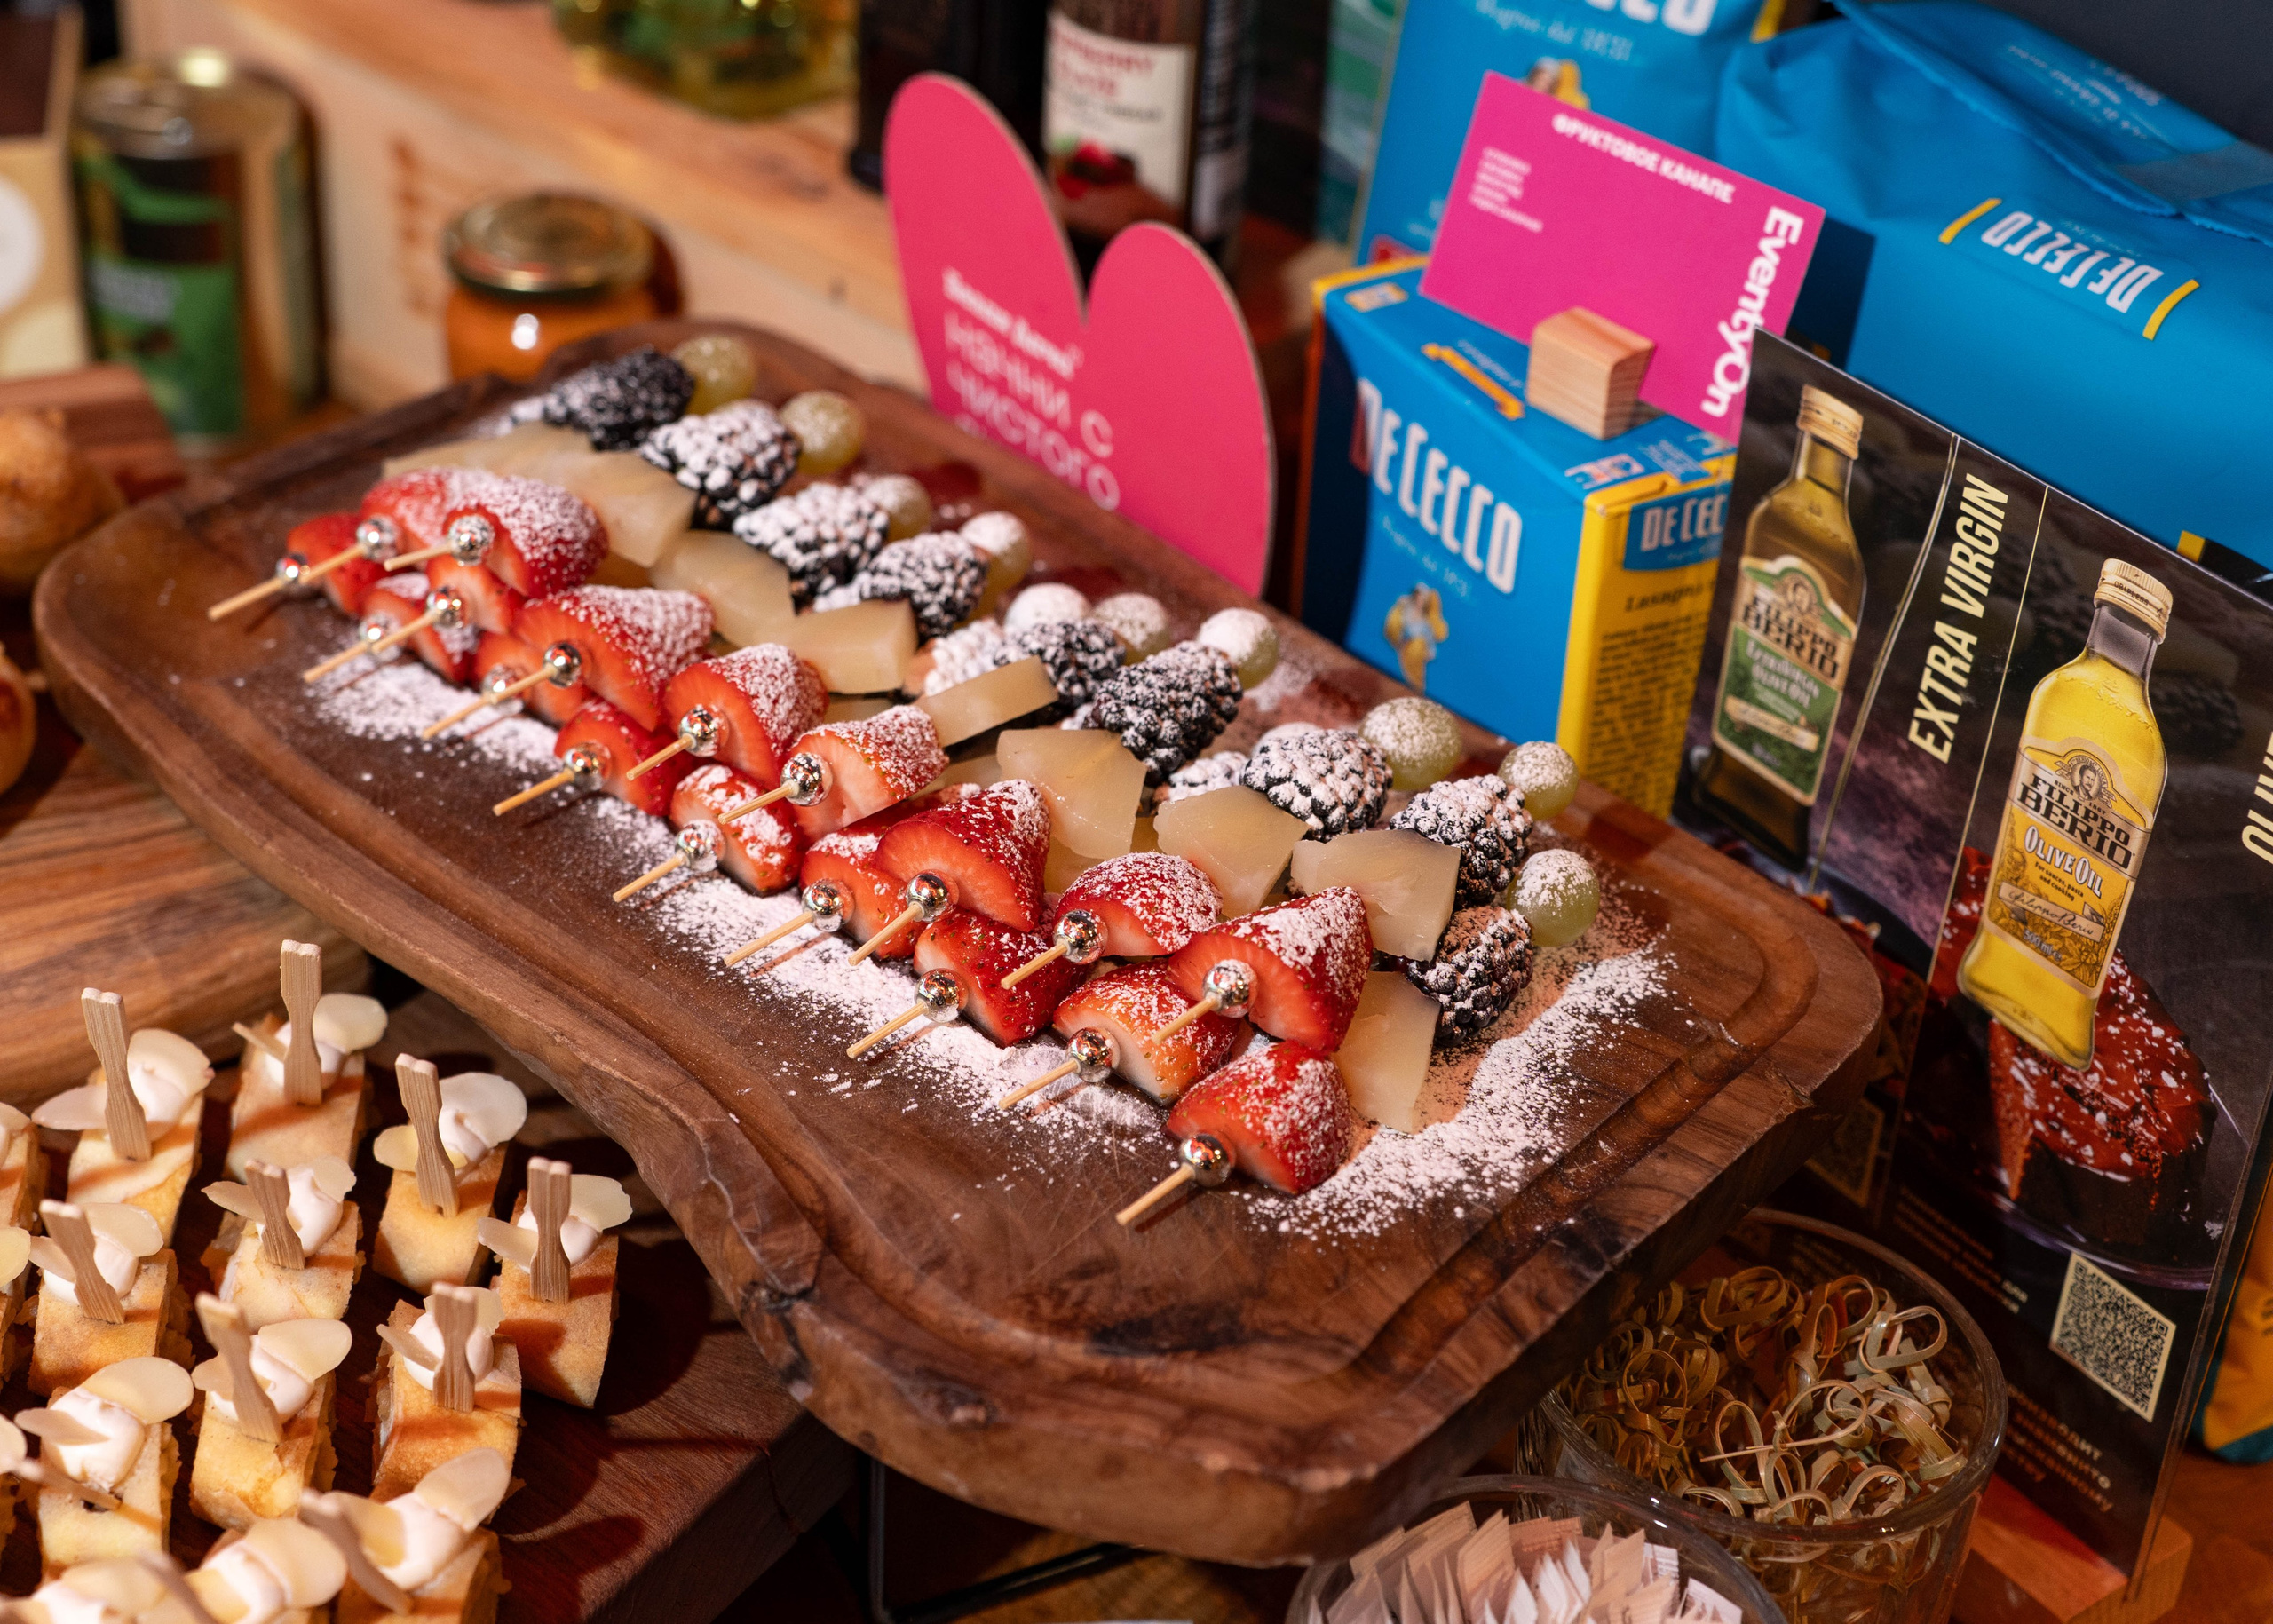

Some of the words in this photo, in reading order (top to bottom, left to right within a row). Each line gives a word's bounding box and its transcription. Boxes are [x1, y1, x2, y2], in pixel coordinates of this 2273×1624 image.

[1550, 112, 1661, 173] ФРУКТОВОЕ
[1659, 156, 1736, 204] КАНАПЕ
[1699, 205, 1804, 418] EventyOn
[1679, 494, 1728, 543] CEC
[1940, 473, 2009, 617] VIRGIN
[1907, 622, 1979, 764] EXTRA
[2016, 781, 2133, 870] BERIO
[2030, 772, 2131, 846] FILIPPO
[2024, 825, 2077, 875] OLIVE
[2073, 856, 2103, 899] OIL
